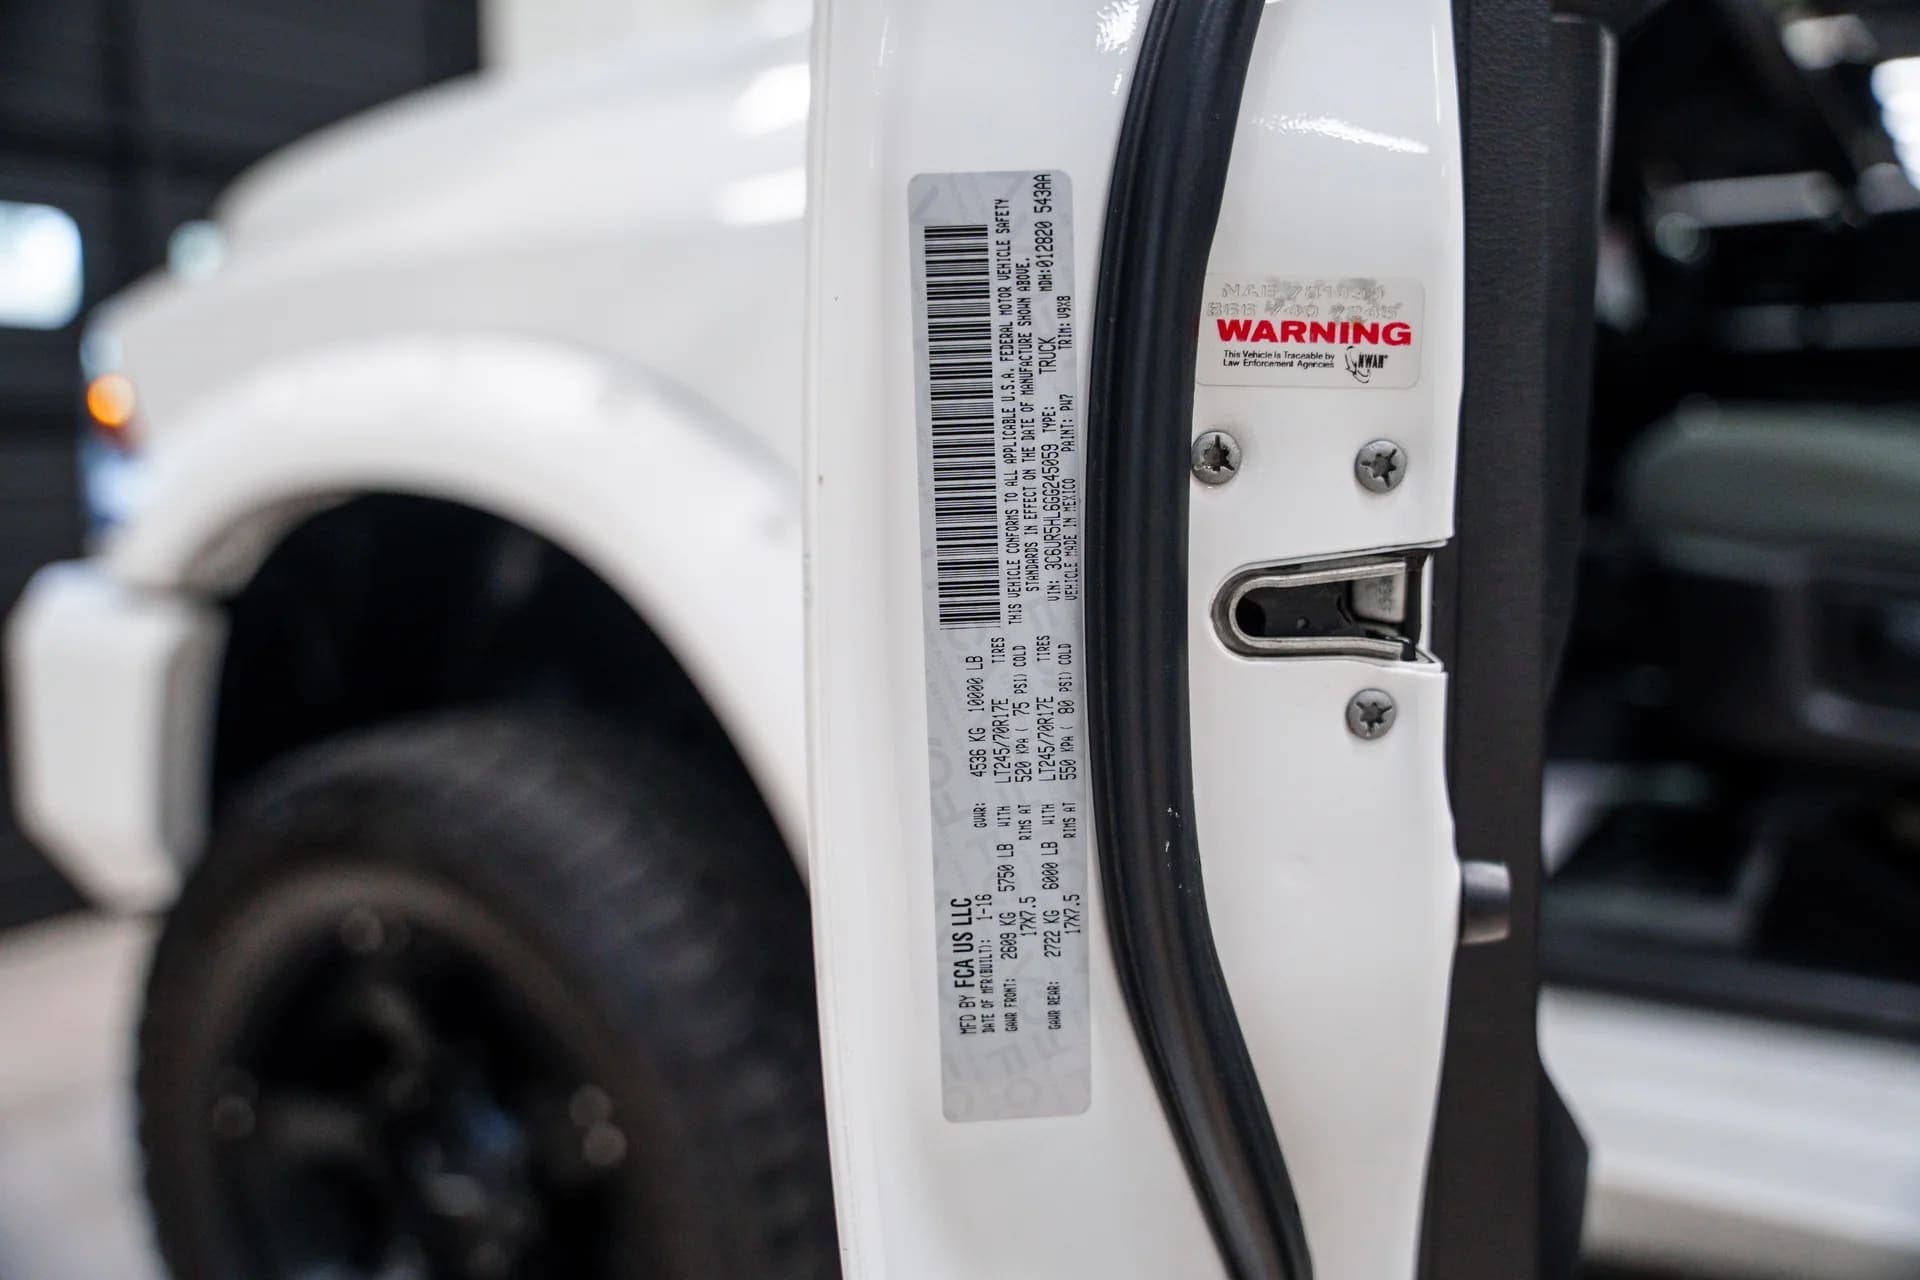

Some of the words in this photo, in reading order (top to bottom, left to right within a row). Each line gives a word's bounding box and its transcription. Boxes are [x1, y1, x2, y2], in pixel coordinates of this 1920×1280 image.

[1033, 173, 1052, 213] 543AA
[994, 199, 1010, 234] SAFETY
[996, 240, 1012, 281] VEHICLE
[1015, 258, 1031, 292] ABOVE.
[997, 286, 1012, 315] MOTOR
[1017, 297, 1032, 326] SHOWN
[999, 321, 1014, 362] FEDERAL
[1057, 323, 1072, 350] TRIM:
[1216, 319, 1412, 346] WARNING
[1017, 332, 1034, 395] MANUFACTURE
[1037, 336, 1057, 375] TRUCK
[1223, 359, 1240, 367] Law
[1243, 359, 1294, 368] Enforcement
[1297, 360, 1335, 369] Agencies
[1224, 350, 1240, 359] This
[1242, 350, 1272, 359] Vehicle
[1283, 351, 1323, 360] Traceable
[1325, 352, 1335, 362] by
[1000, 368, 1015, 402] U.S.A.
[1019, 401, 1034, 412] OF
[1059, 394, 1074, 411] PW7
[1020, 418, 1035, 441] DATE
[1041, 406, 1056, 433] TYPE:
[1001, 407, 1017, 464] APPLICABLE
[1060, 419, 1075, 452] PAINT:
[1021, 446, 1036, 463] THE
[1004, 470, 1018, 487] ALL
[1022, 469, 1036, 480] ON
[1004, 492, 1018, 503] TO
[1022, 486, 1038, 520] EFFECT
[1062, 478, 1076, 512] MEXICO
[1041, 444, 1062, 571] 3C6UR5HL6GG245059
[1005, 509, 1020, 554] CONFORMS
[1024, 525, 1038, 535] IN
[1063, 518, 1077, 527] IN
[1063, 535, 1077, 556] MADE
[1024, 542, 1040, 592] STANDARDS
[1006, 559, 1021, 598] VEHICLE
[1064, 563, 1078, 600] VEHICLE
[1047, 580, 1061, 601] VIN:
[1008, 603, 1022, 625] THIS
[990, 637, 1005, 664] TIRES
[1012, 645, 1027, 667] COLD
[1036, 635, 1051, 662] TIRES
[1057, 643, 1072, 665] COLD
[965, 655, 983, 670] LB
[1013, 674, 1028, 694] PSI)
[1058, 672, 1072, 692] PSI)
[966, 677, 985, 712] 10000
[1012, 702, 1030, 716] 75
[1057, 700, 1075, 714] 80
[968, 727, 986, 742] KG
[991, 698, 1011, 783] LT245/70R17E
[1036, 696, 1056, 781] LT245/70R17E
[1060, 736, 1074, 752] KPA
[1015, 738, 1029, 754] KPA
[969, 749, 987, 777] 4536
[1014, 761, 1032, 783] 520
[1059, 759, 1077, 781] 550
[973, 803, 988, 828] GVWR:
[997, 806, 1011, 827] WITH
[1017, 804, 1031, 814] AT
[1041, 804, 1055, 825] WITH
[1062, 802, 1076, 812] AT
[1018, 819, 1032, 841] RIMS
[1062, 817, 1077, 838] RIMS
[996, 843, 1014, 858] LB
[1040, 841, 1058, 856] LB
[997, 864, 1015, 892] 5750
[1041, 862, 1059, 890] 6000
[950, 898, 972, 926] LLC
[974, 894, 993, 920] 1-16
[1018, 896, 1037, 936] 17X7.5
[1042, 910, 1060, 924] KG
[1063, 894, 1081, 934] 17X7.5
[998, 912, 1016, 926] KG
[952, 932, 974, 953] US
[999, 932, 1018, 960] 2609
[1043, 930, 1061, 958] 2722
[953, 958, 975, 988] FCA
[978, 939, 993, 994] MFR(BUILT):
[958, 995, 976, 1008] BY
[980, 999, 994, 1009] OF
[1003, 978, 1017, 1008] FRONT:
[1046, 981, 1061, 1006] REAR:
[959, 1014, 976, 1035] MFD
[981, 1013, 995, 1033] DATE
[1004, 1012, 1018, 1032] GAWR
[1047, 1010, 1061, 1030] GAWR
